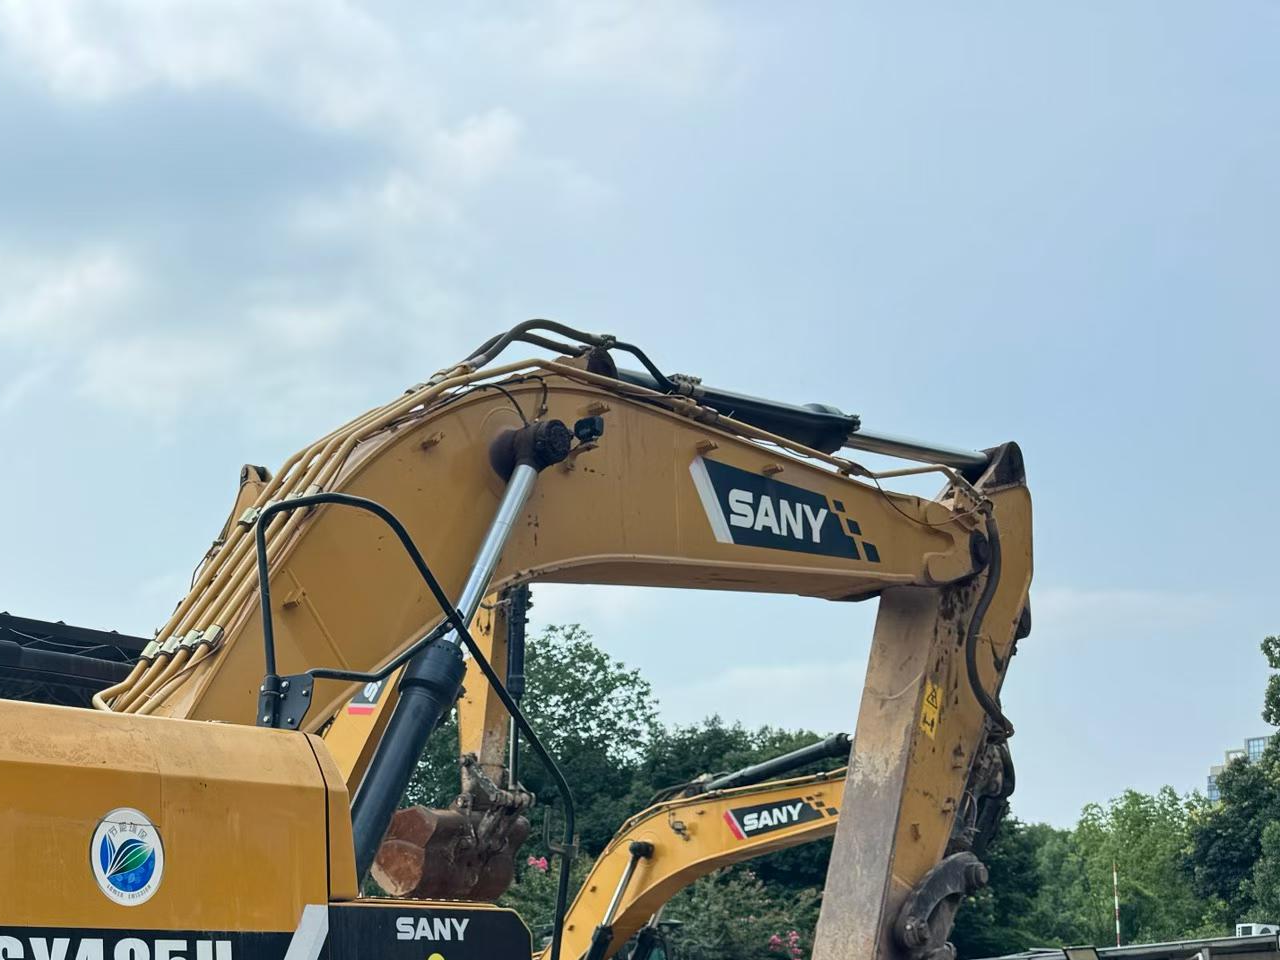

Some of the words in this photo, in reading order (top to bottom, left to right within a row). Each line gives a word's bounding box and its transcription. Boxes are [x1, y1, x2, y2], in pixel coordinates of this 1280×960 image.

[728, 488, 828, 543] SANY
[743, 802, 803, 831] SANY
[396, 917, 470, 941] SANY
